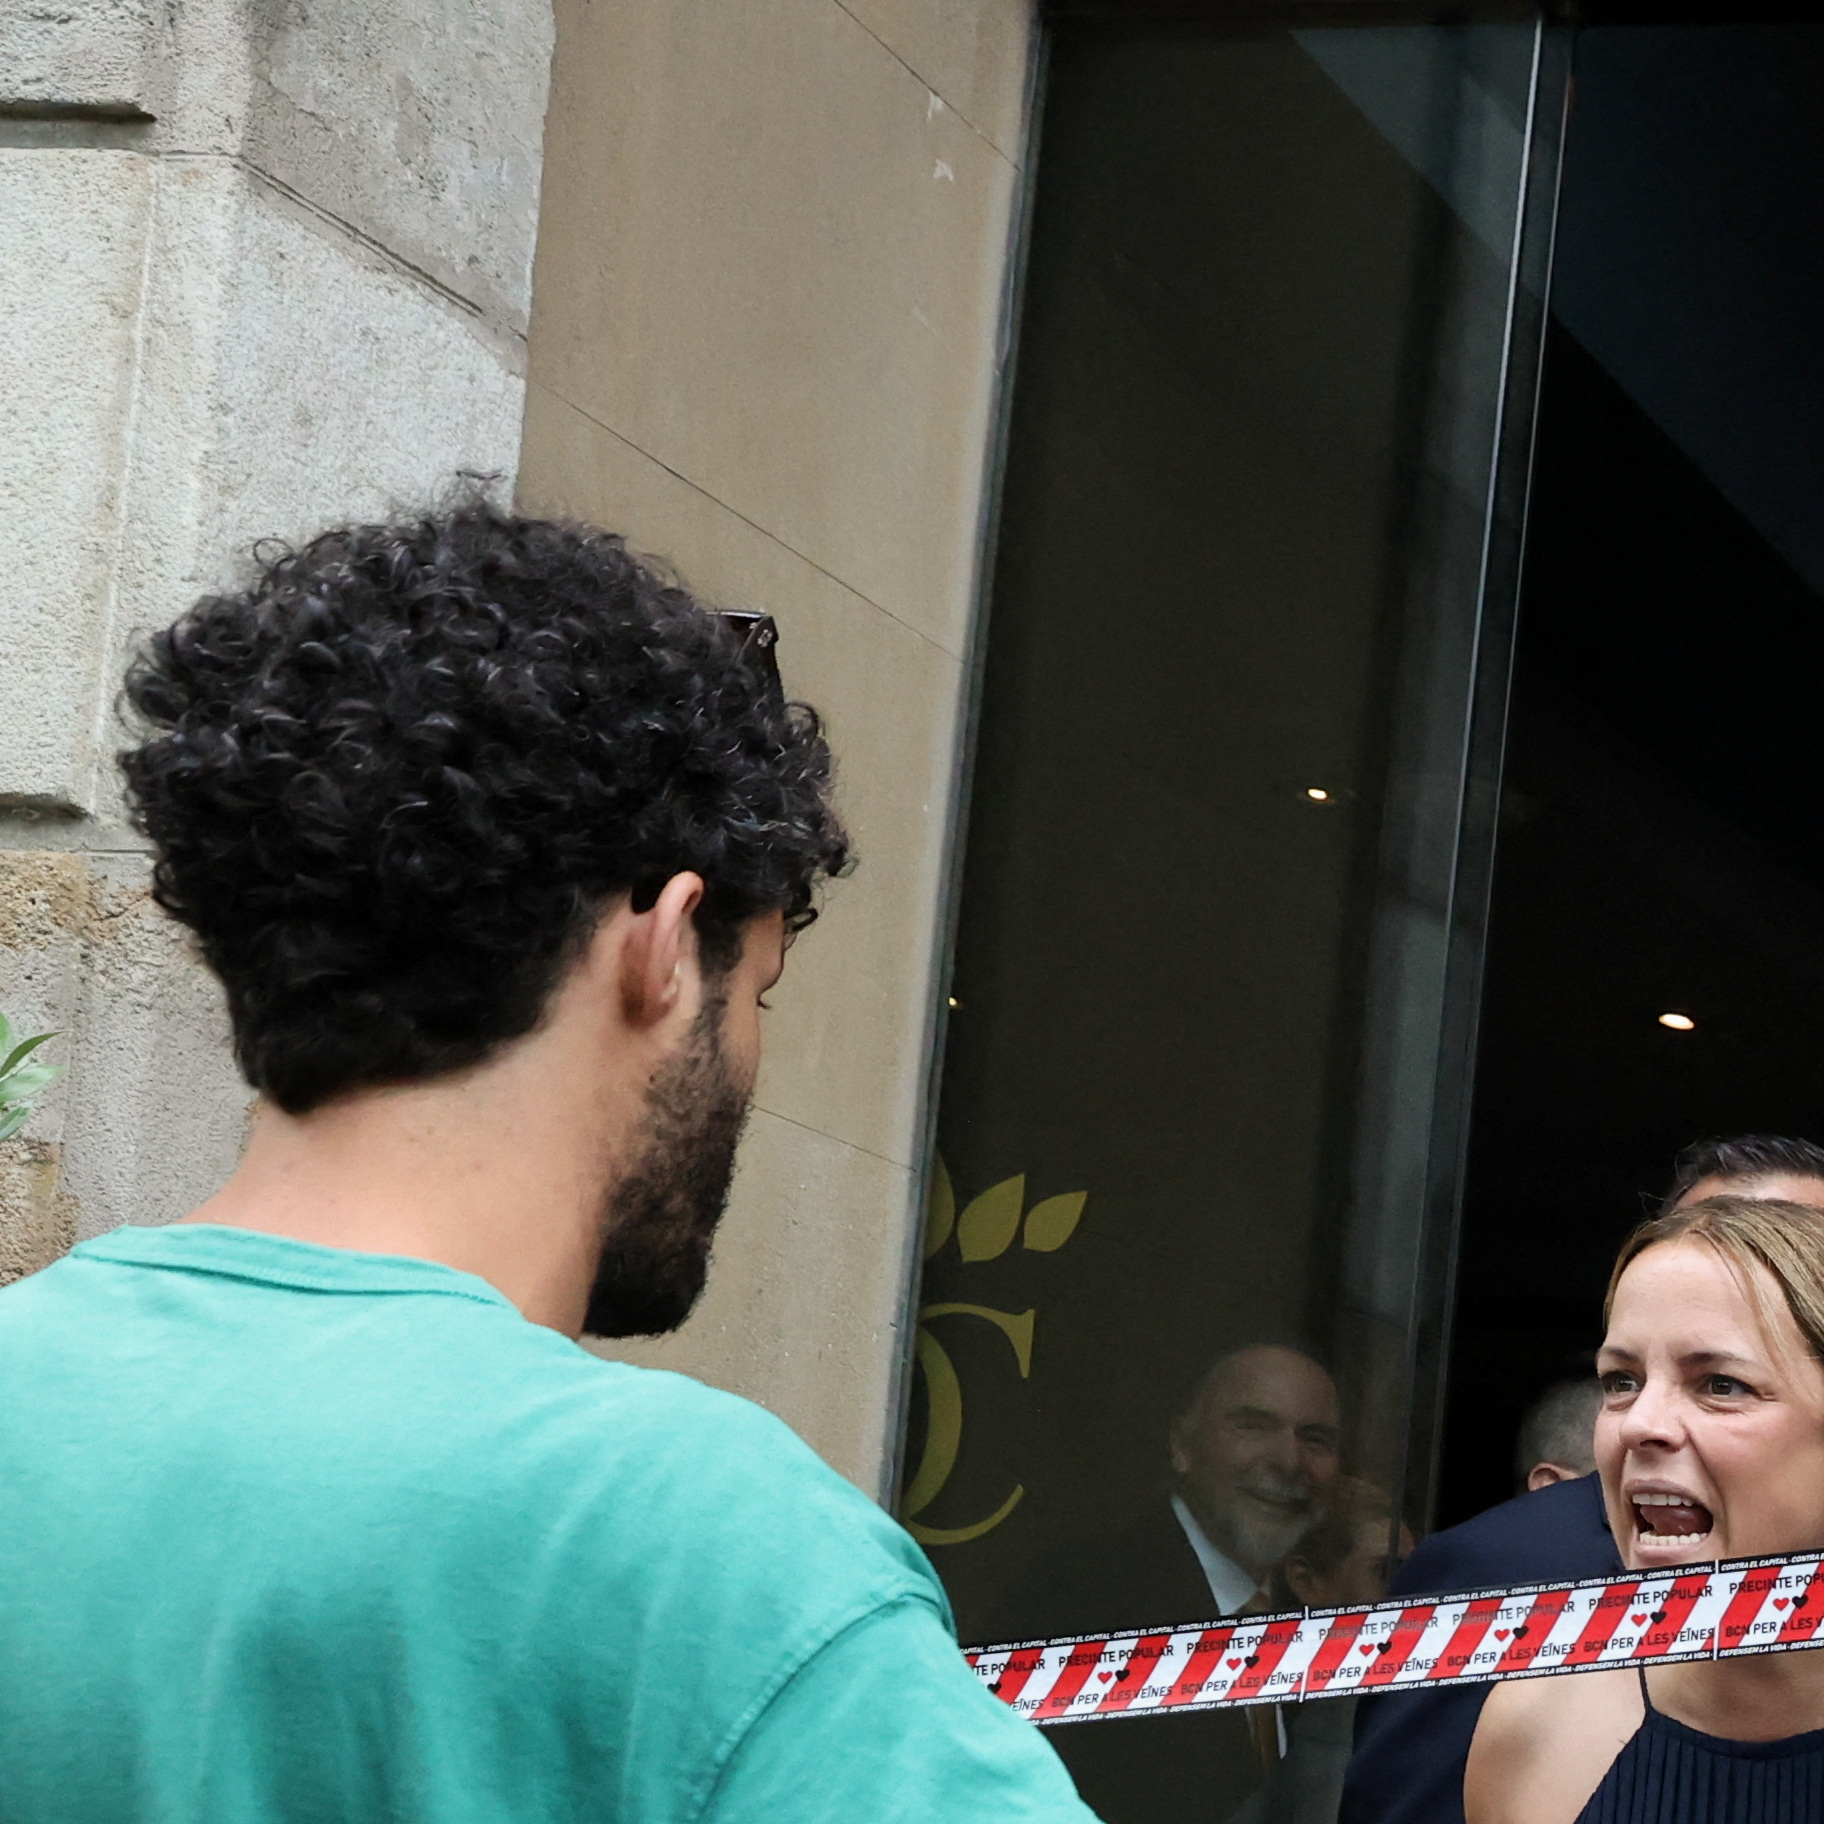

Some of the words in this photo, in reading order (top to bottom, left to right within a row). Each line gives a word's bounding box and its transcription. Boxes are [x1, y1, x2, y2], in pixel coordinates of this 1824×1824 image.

[1729, 1574, 1792, 1595] PRECINTE
[1588, 1590, 1649, 1610] PRECINTE
[1652, 1583, 1712, 1604] POPULAR
[1725, 1622, 1750, 1638] BCN
[1752, 1620, 1776, 1635] PER
[1779, 1620, 1787, 1633] A
[1791, 1616, 1814, 1631] LES
[1610, 1635, 1633, 1650] PER
[1636, 1635, 1643, 1649] A
[1647, 1632, 1669, 1646] LES
